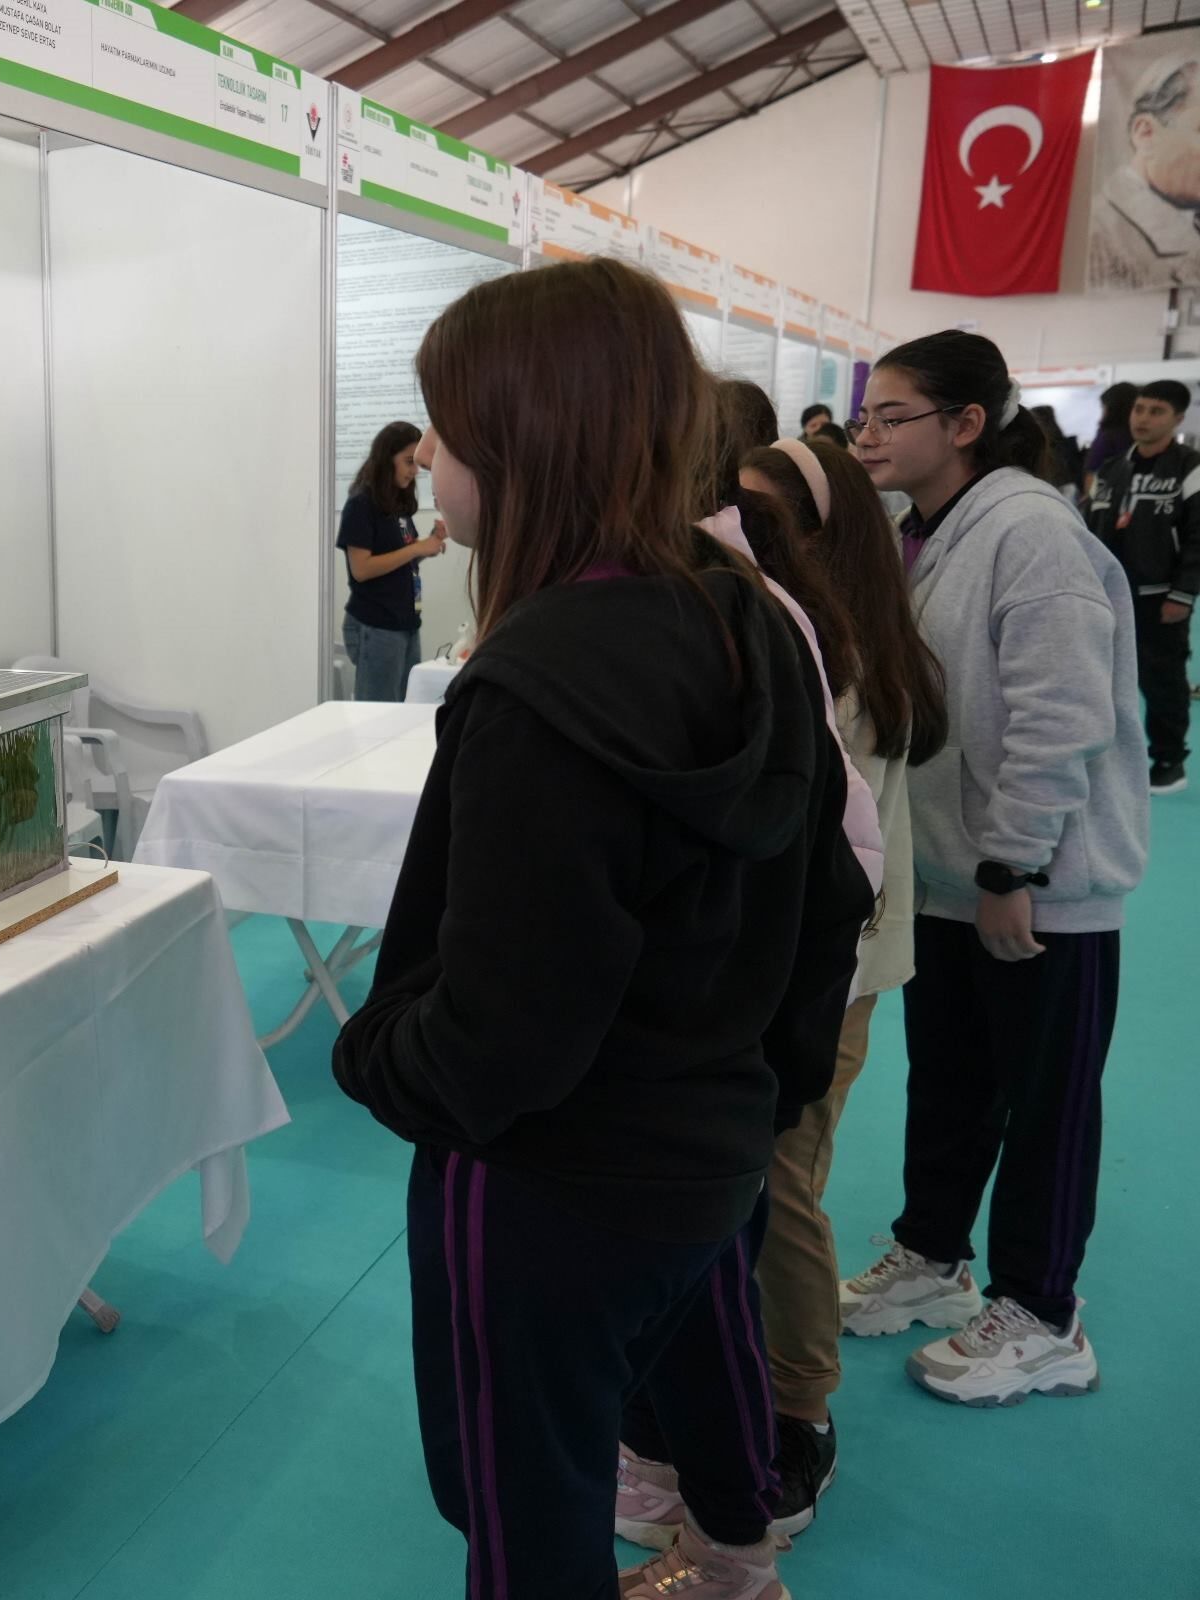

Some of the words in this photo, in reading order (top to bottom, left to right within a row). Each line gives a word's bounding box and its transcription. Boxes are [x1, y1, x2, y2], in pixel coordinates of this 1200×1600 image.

[0, 4, 24, 22] MUSTAFA
[45, 21, 61, 35] BOLAT
[0, 20, 20, 35] ZEYNEP
[20, 28, 38, 43] SEVDE
[281, 103, 288, 123] 17
[1154, 500, 1174, 515] 75
